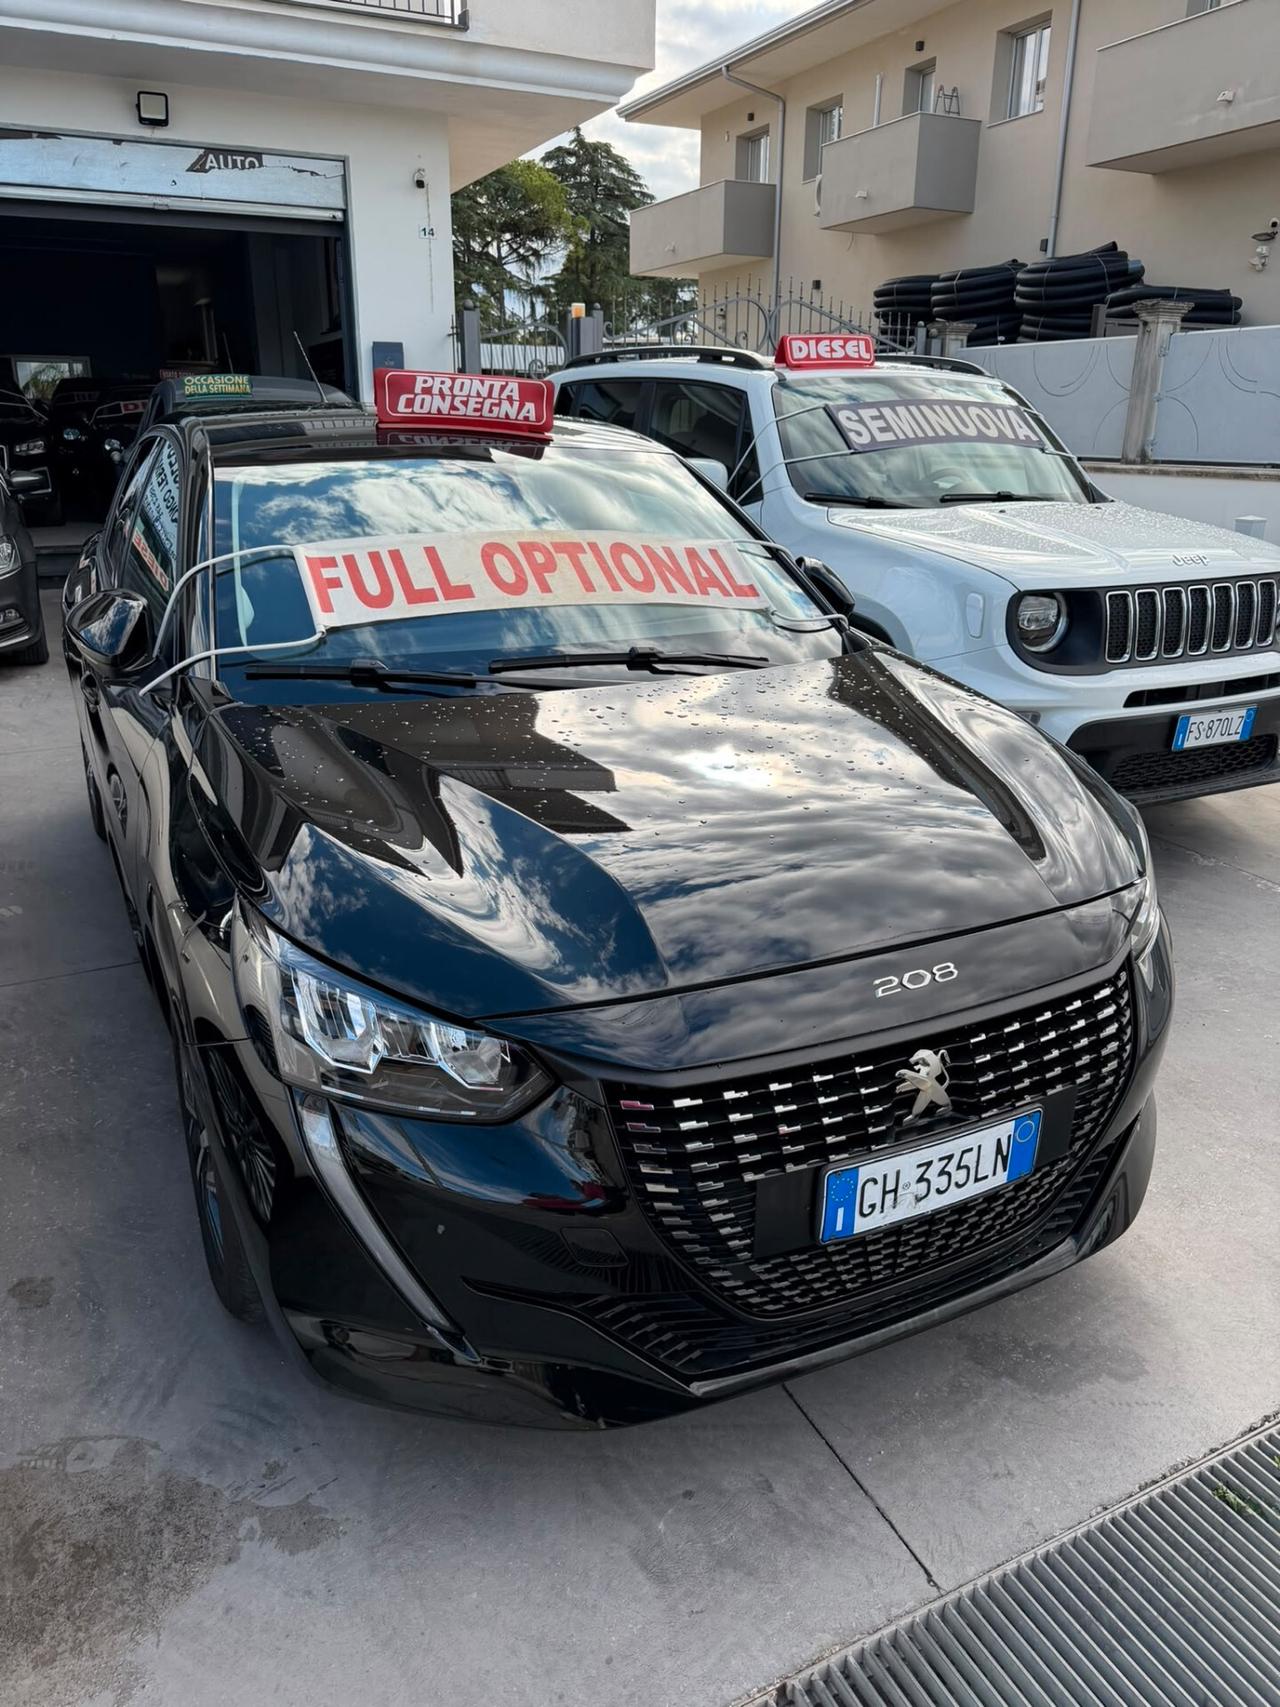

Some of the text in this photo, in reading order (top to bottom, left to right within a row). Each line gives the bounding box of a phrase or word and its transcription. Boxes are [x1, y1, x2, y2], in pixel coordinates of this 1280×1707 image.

[205, 153, 260, 169] AUTO
[421, 227, 435, 237] 14
[790, 339, 872, 360] DIESEL
[184, 376, 249, 385] OCCASIONE
[184, 384, 251, 395] DELLA SETTIMANA
[414, 376, 520, 400] PRONTA
[397, 394, 537, 422] CONSEGNA
[837, 404, 1040, 445] SEMINUOVA
[1172, 554, 1208, 567] Jeep
[306, 540, 761, 614] FULL OPTIONAL
[873, 962, 958, 998] 208
